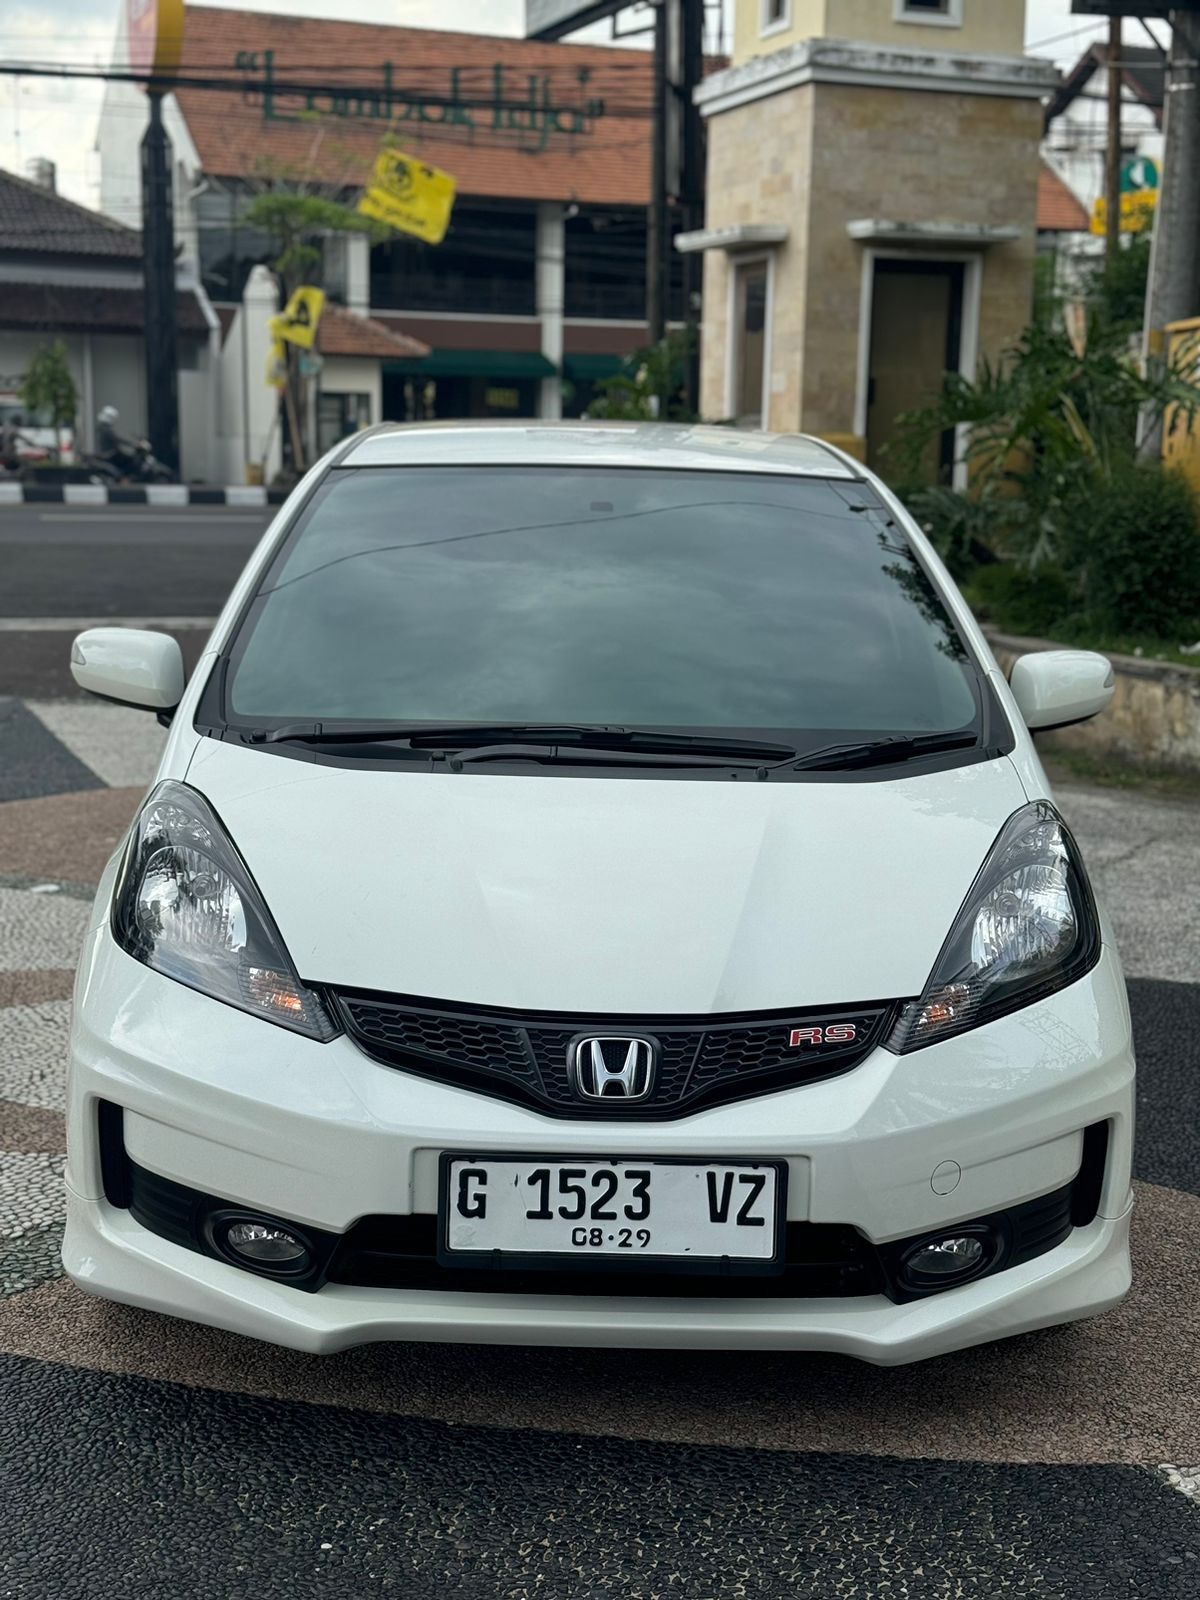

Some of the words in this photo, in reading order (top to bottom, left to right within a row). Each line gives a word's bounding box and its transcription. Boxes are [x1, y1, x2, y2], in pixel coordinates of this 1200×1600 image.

[789, 1023, 856, 1047] RS
[456, 1168, 487, 1220] G
[525, 1168, 651, 1221] 1523
[706, 1170, 767, 1227] VZ
